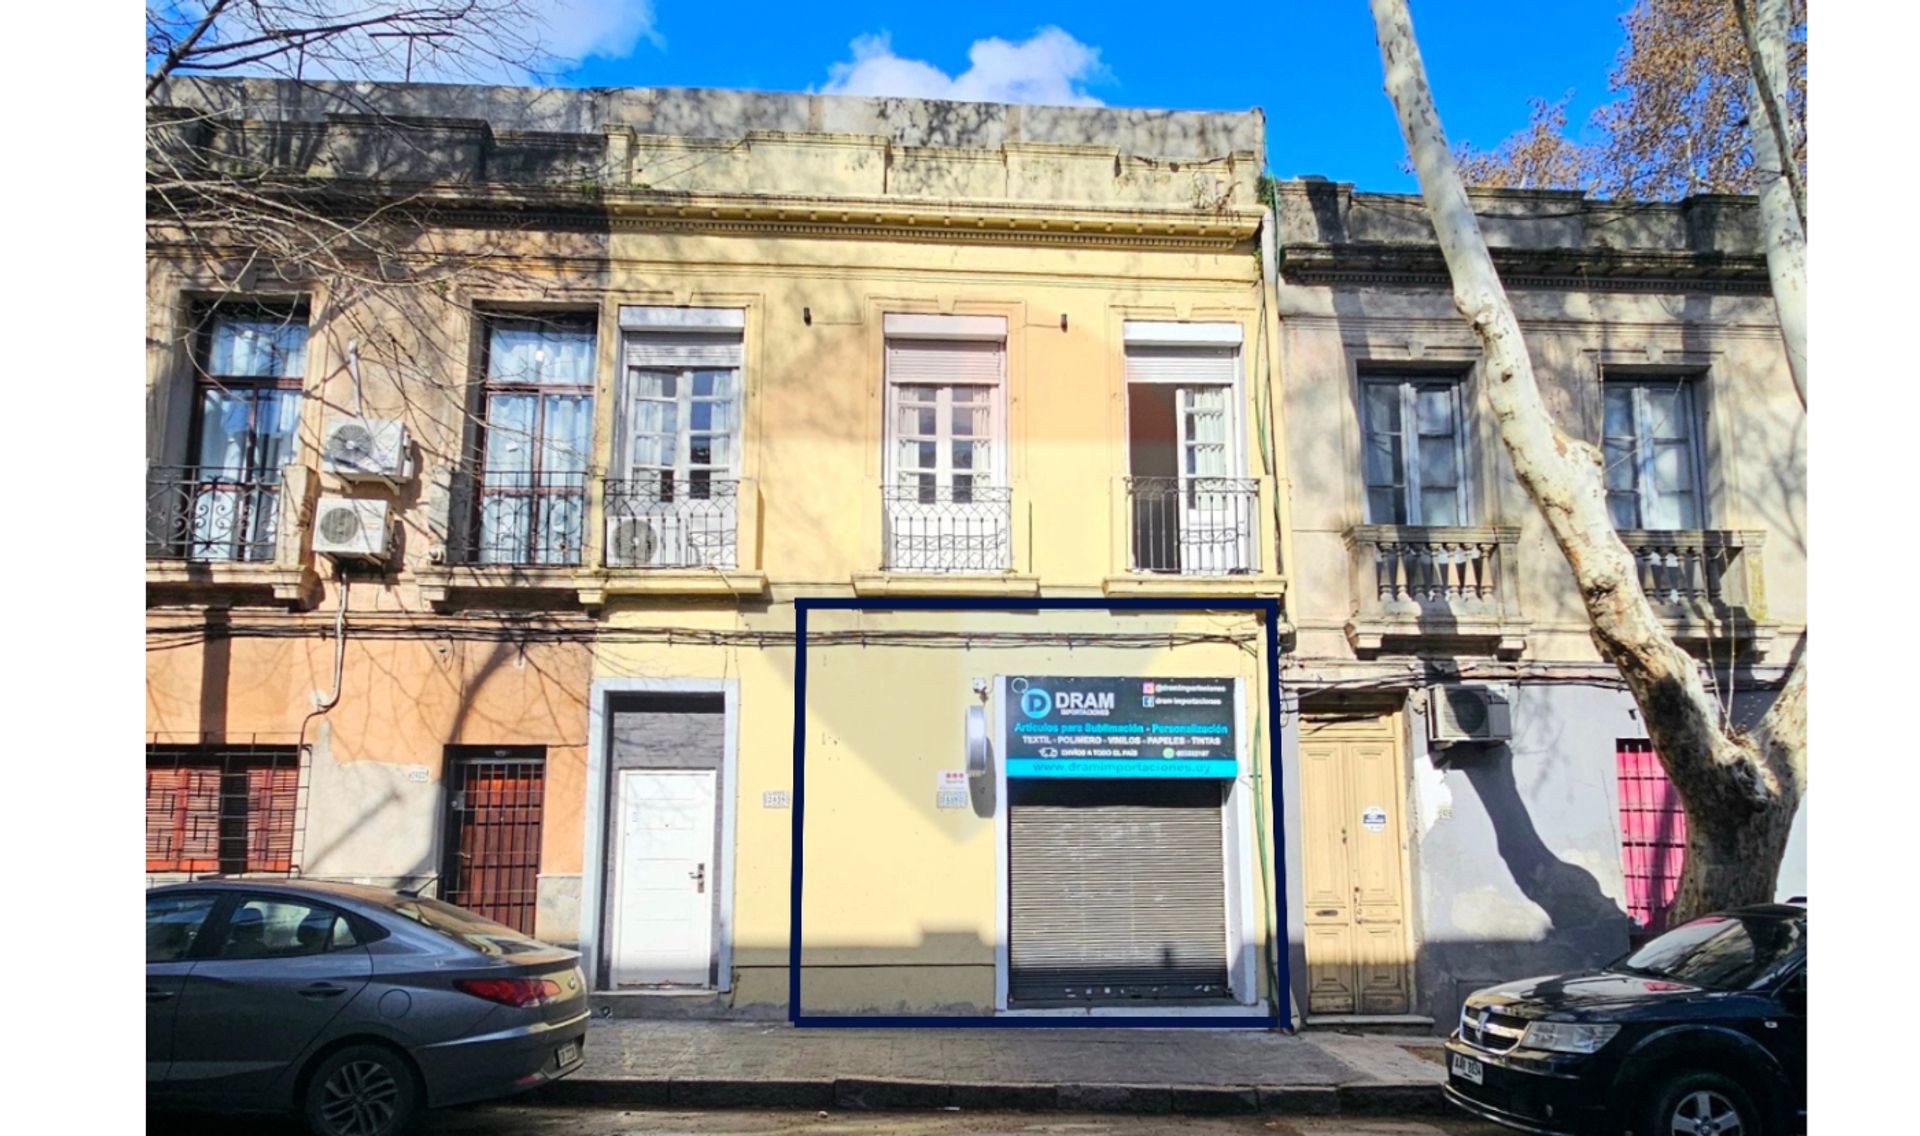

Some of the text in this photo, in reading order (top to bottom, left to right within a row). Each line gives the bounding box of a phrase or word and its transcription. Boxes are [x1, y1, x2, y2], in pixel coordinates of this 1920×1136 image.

[1055, 691, 1115, 709] DRAM
[1060, 724, 1083, 735] para
[1084, 722, 1144, 734] Sublimación
[1151, 723, 1228, 735] Personalización
[1022, 735, 1050, 744] TEXTIL
[1107, 735, 1141, 745] VINILOS
[1146, 736, 1185, 746] PAPELES
[1191, 736, 1222, 746] TINTAS
[1093, 749, 1112, 757] TODO
[1032, 762, 1211, 775] www.dramimportaciones.uy
